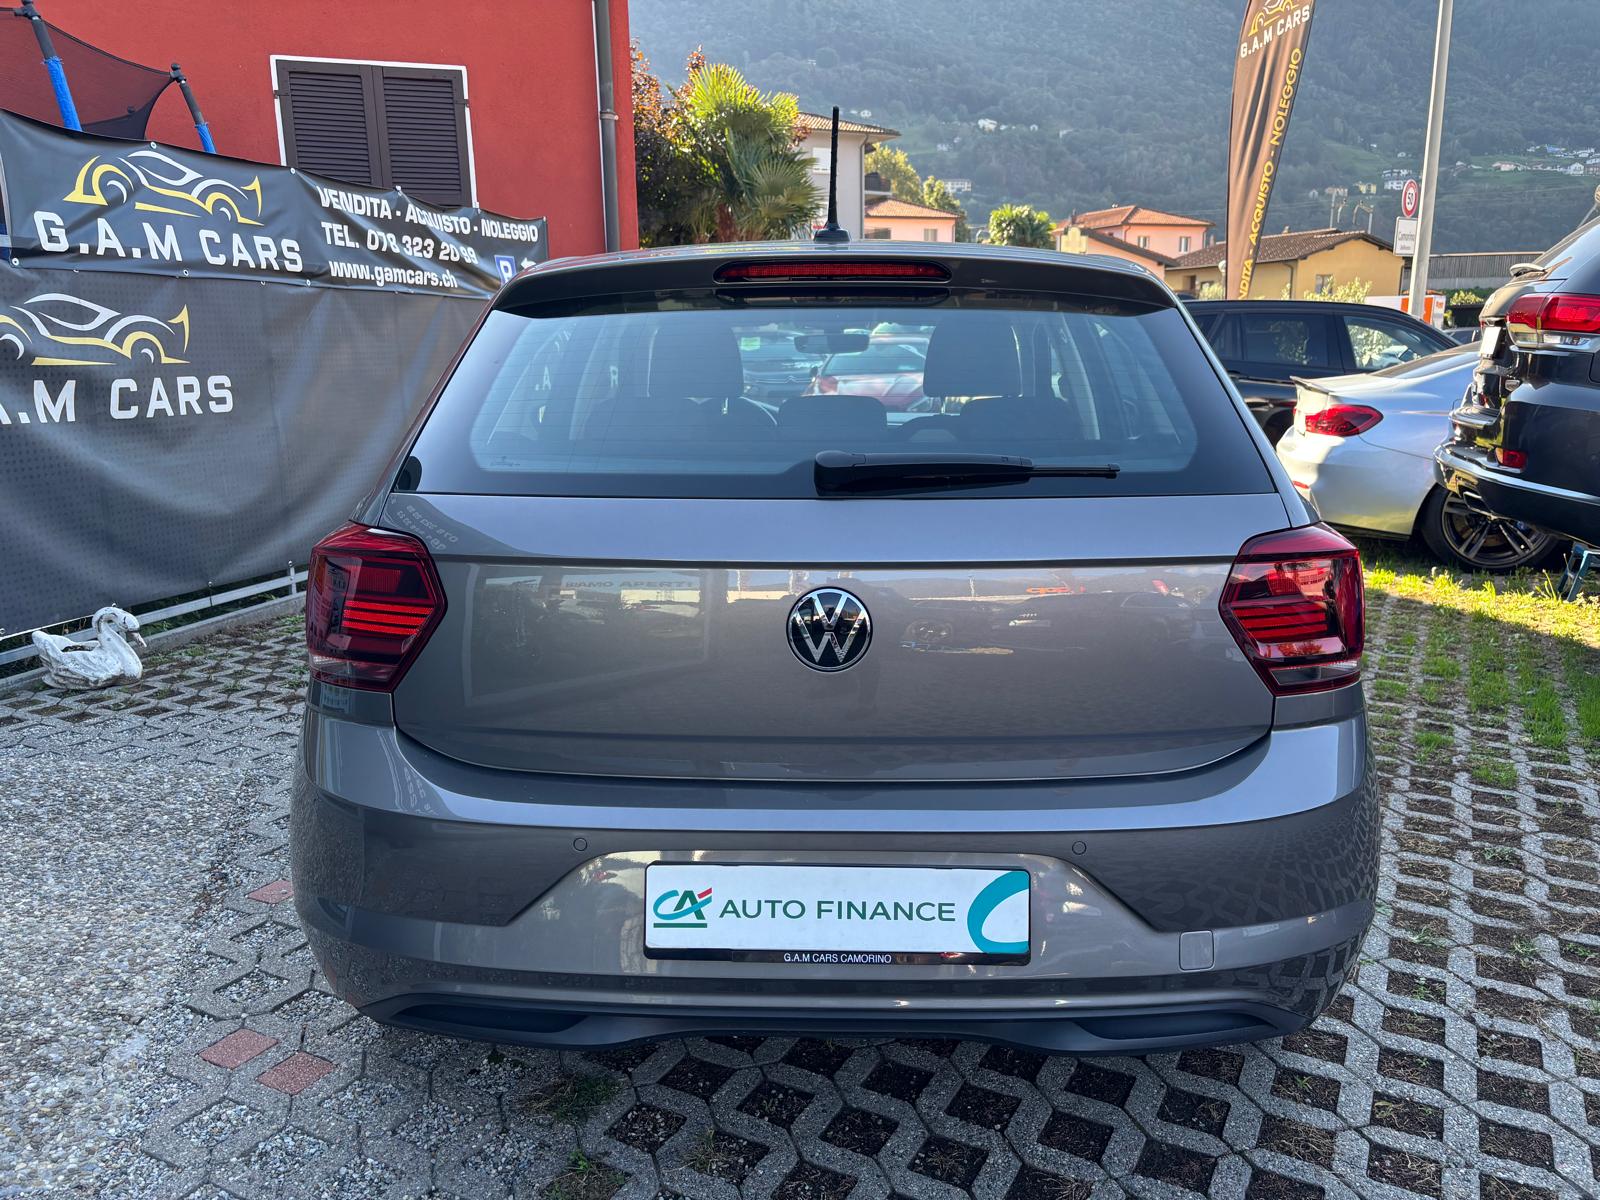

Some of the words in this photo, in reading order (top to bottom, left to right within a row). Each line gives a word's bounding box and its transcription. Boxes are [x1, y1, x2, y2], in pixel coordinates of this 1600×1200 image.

[1241, 25, 1273, 58] G.A.M
[1277, 5, 1310, 36] CARS
[1249, 160, 1274, 246] ACQUISTO
[1269, 47, 1301, 146] NOLEGGIO
[316, 186, 392, 220] VENDITA
[481, 218, 539, 243] NOLEGGIO
[33, 210, 183, 262] G.A.M
[199, 229, 303, 272] CARS
[321, 221, 360, 249] TEL.
[366, 229, 400, 254] 078
[401, 235, 435, 259] 323
[438, 243, 460, 262] 20
[461, 246, 479, 265] 99
[329, 261, 458, 288] www.gamcars.ch
[500, 260, 513, 284] P
[110, 375, 233, 420] CARS
[720, 899, 806, 919] AUTO
[816, 900, 956, 922] FINANCE
[783, 952, 810, 962] G.A.M
[812, 953, 838, 963] CARS
[840, 954, 892, 964] CAMORINO
